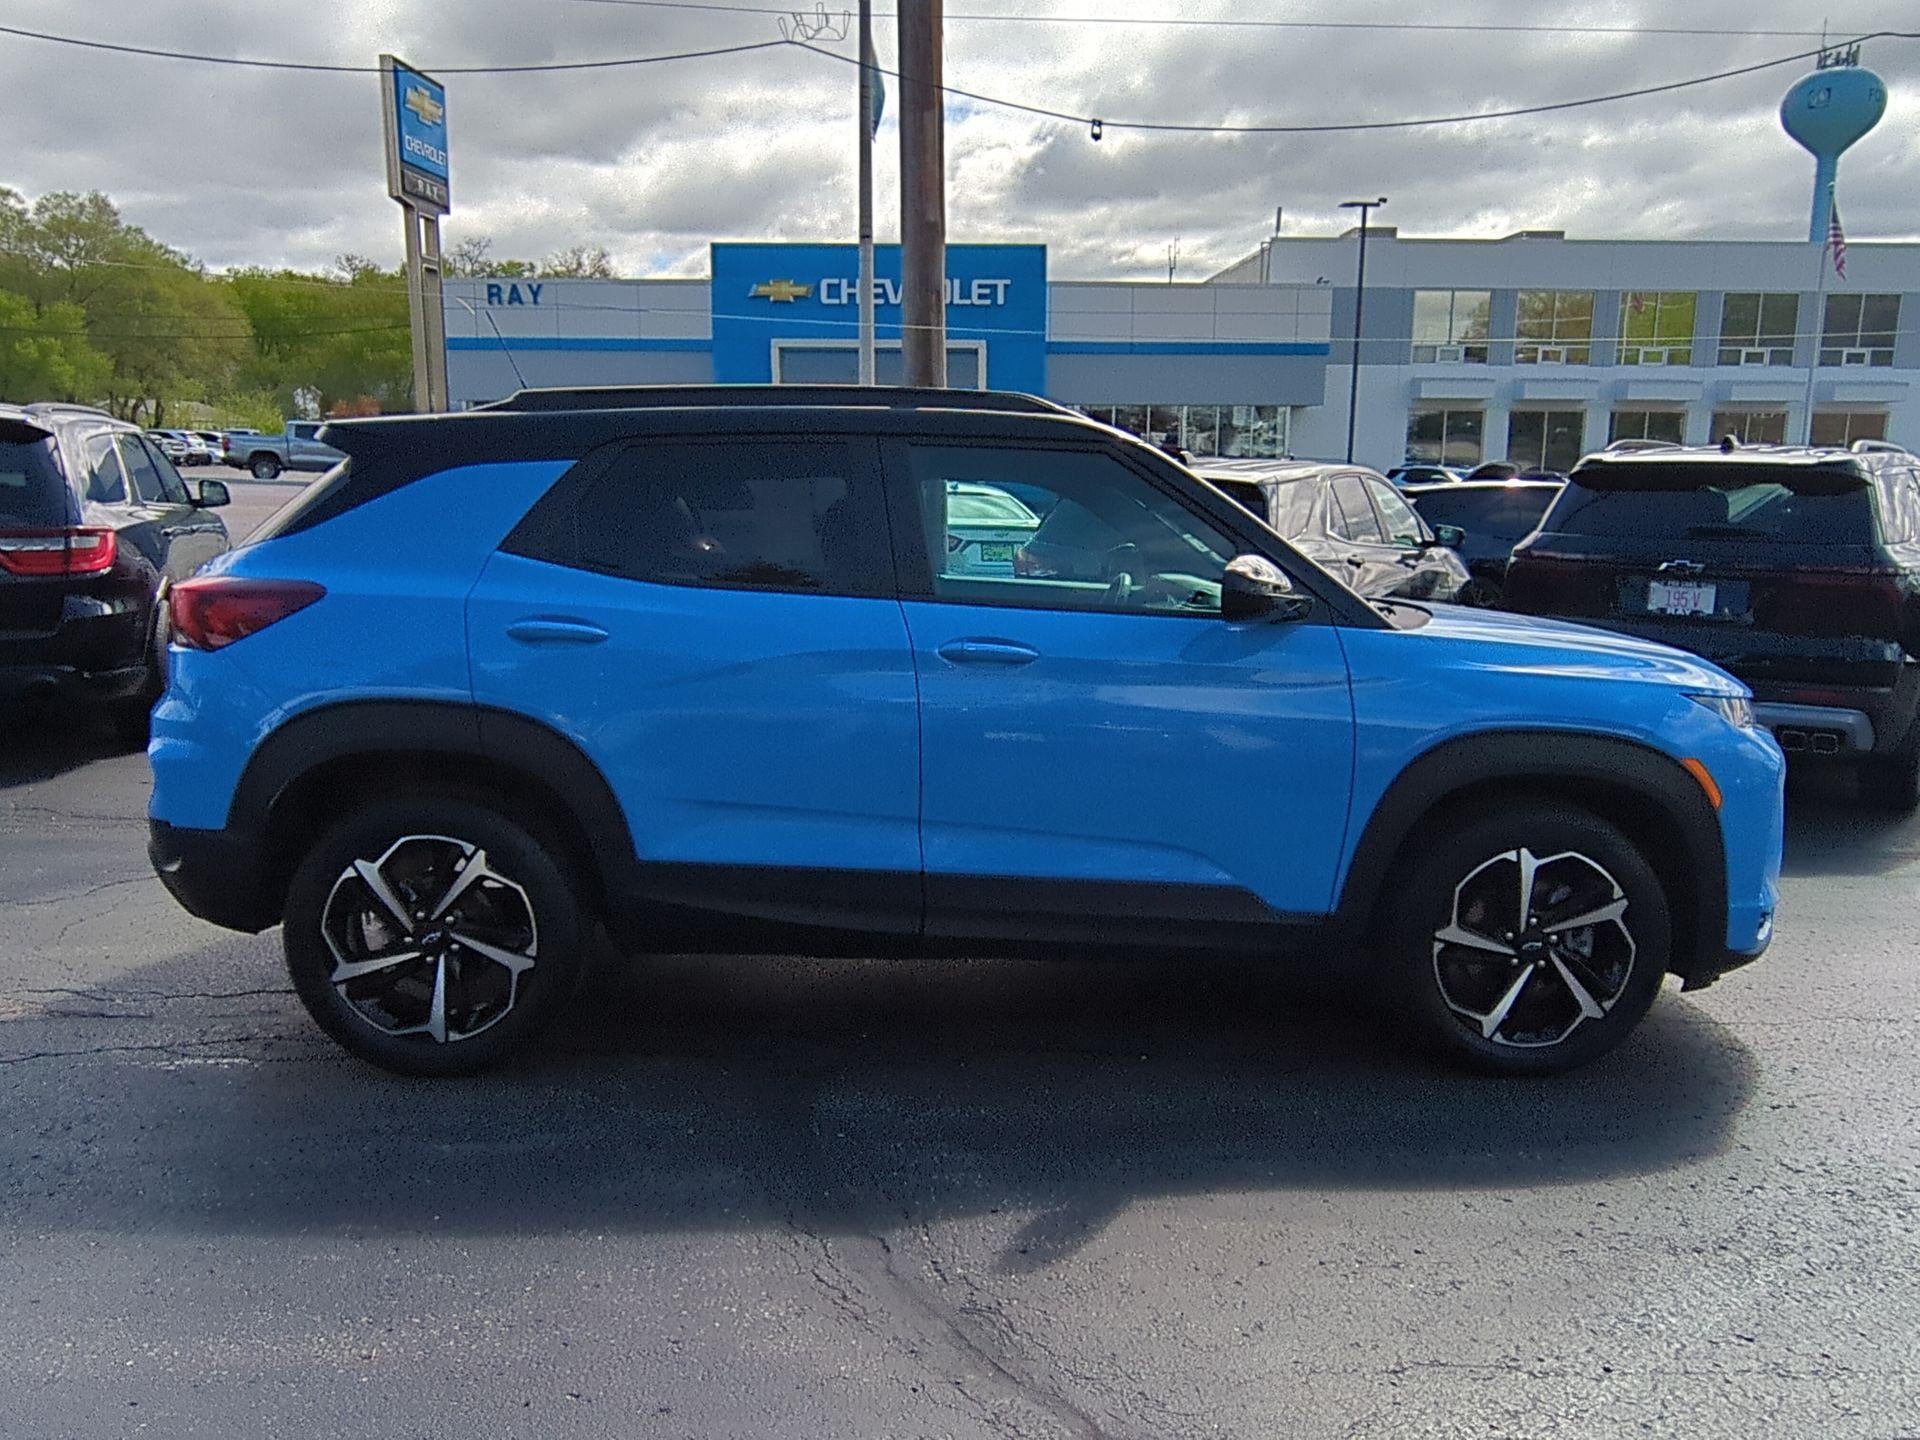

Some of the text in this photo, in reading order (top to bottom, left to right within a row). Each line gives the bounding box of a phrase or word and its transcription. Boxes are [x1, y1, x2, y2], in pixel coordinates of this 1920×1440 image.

[405, 134, 447, 166] CHEVROLET
[417, 179, 438, 201] RAY
[487, 283, 544, 306] RAY
[820, 278, 1011, 305] CHEVLET
